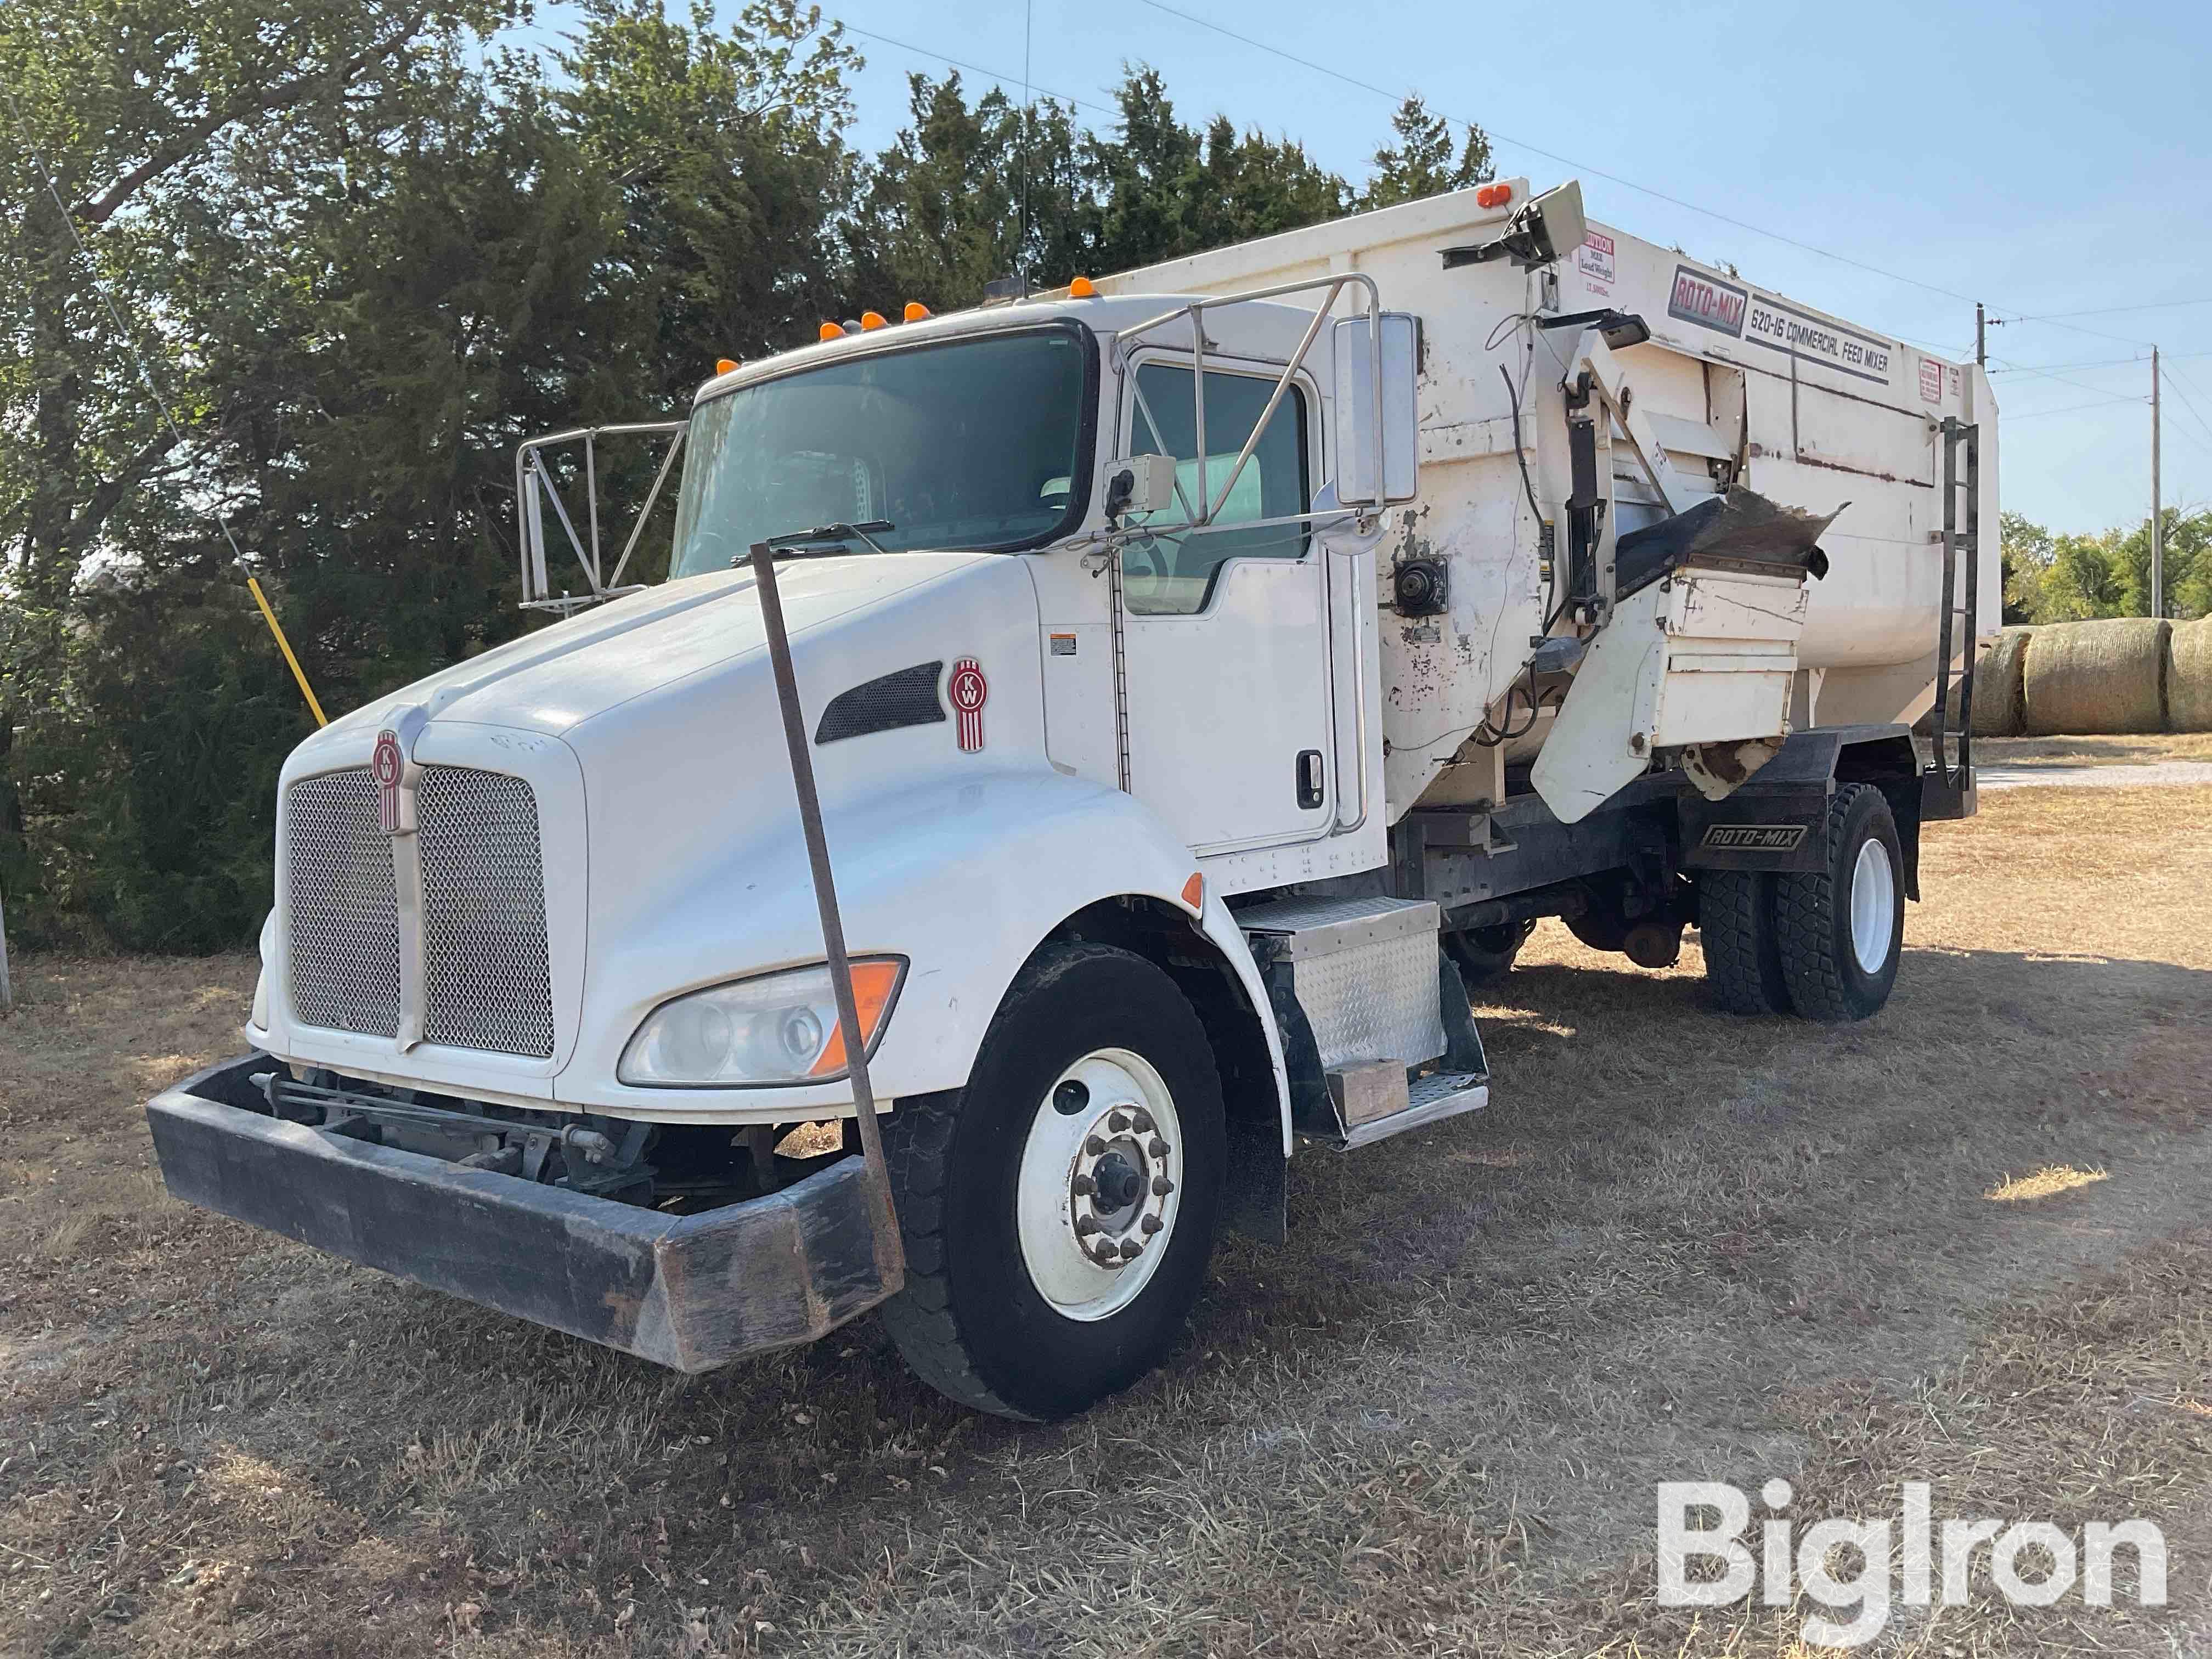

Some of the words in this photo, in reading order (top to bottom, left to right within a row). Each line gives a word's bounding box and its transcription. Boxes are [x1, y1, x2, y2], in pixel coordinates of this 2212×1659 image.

[1587, 233, 1612, 253] UTION
[1675, 276, 1743, 326] ROTO-MIX
[1751, 308, 1784, 338] 620-16
[1786, 321, 1838, 356] COMMERCIAL
[1842, 341, 1861, 364] FEED
[1864, 349, 1888, 373] MIXER
[1708, 830, 1801, 846] ROTO-MIX
